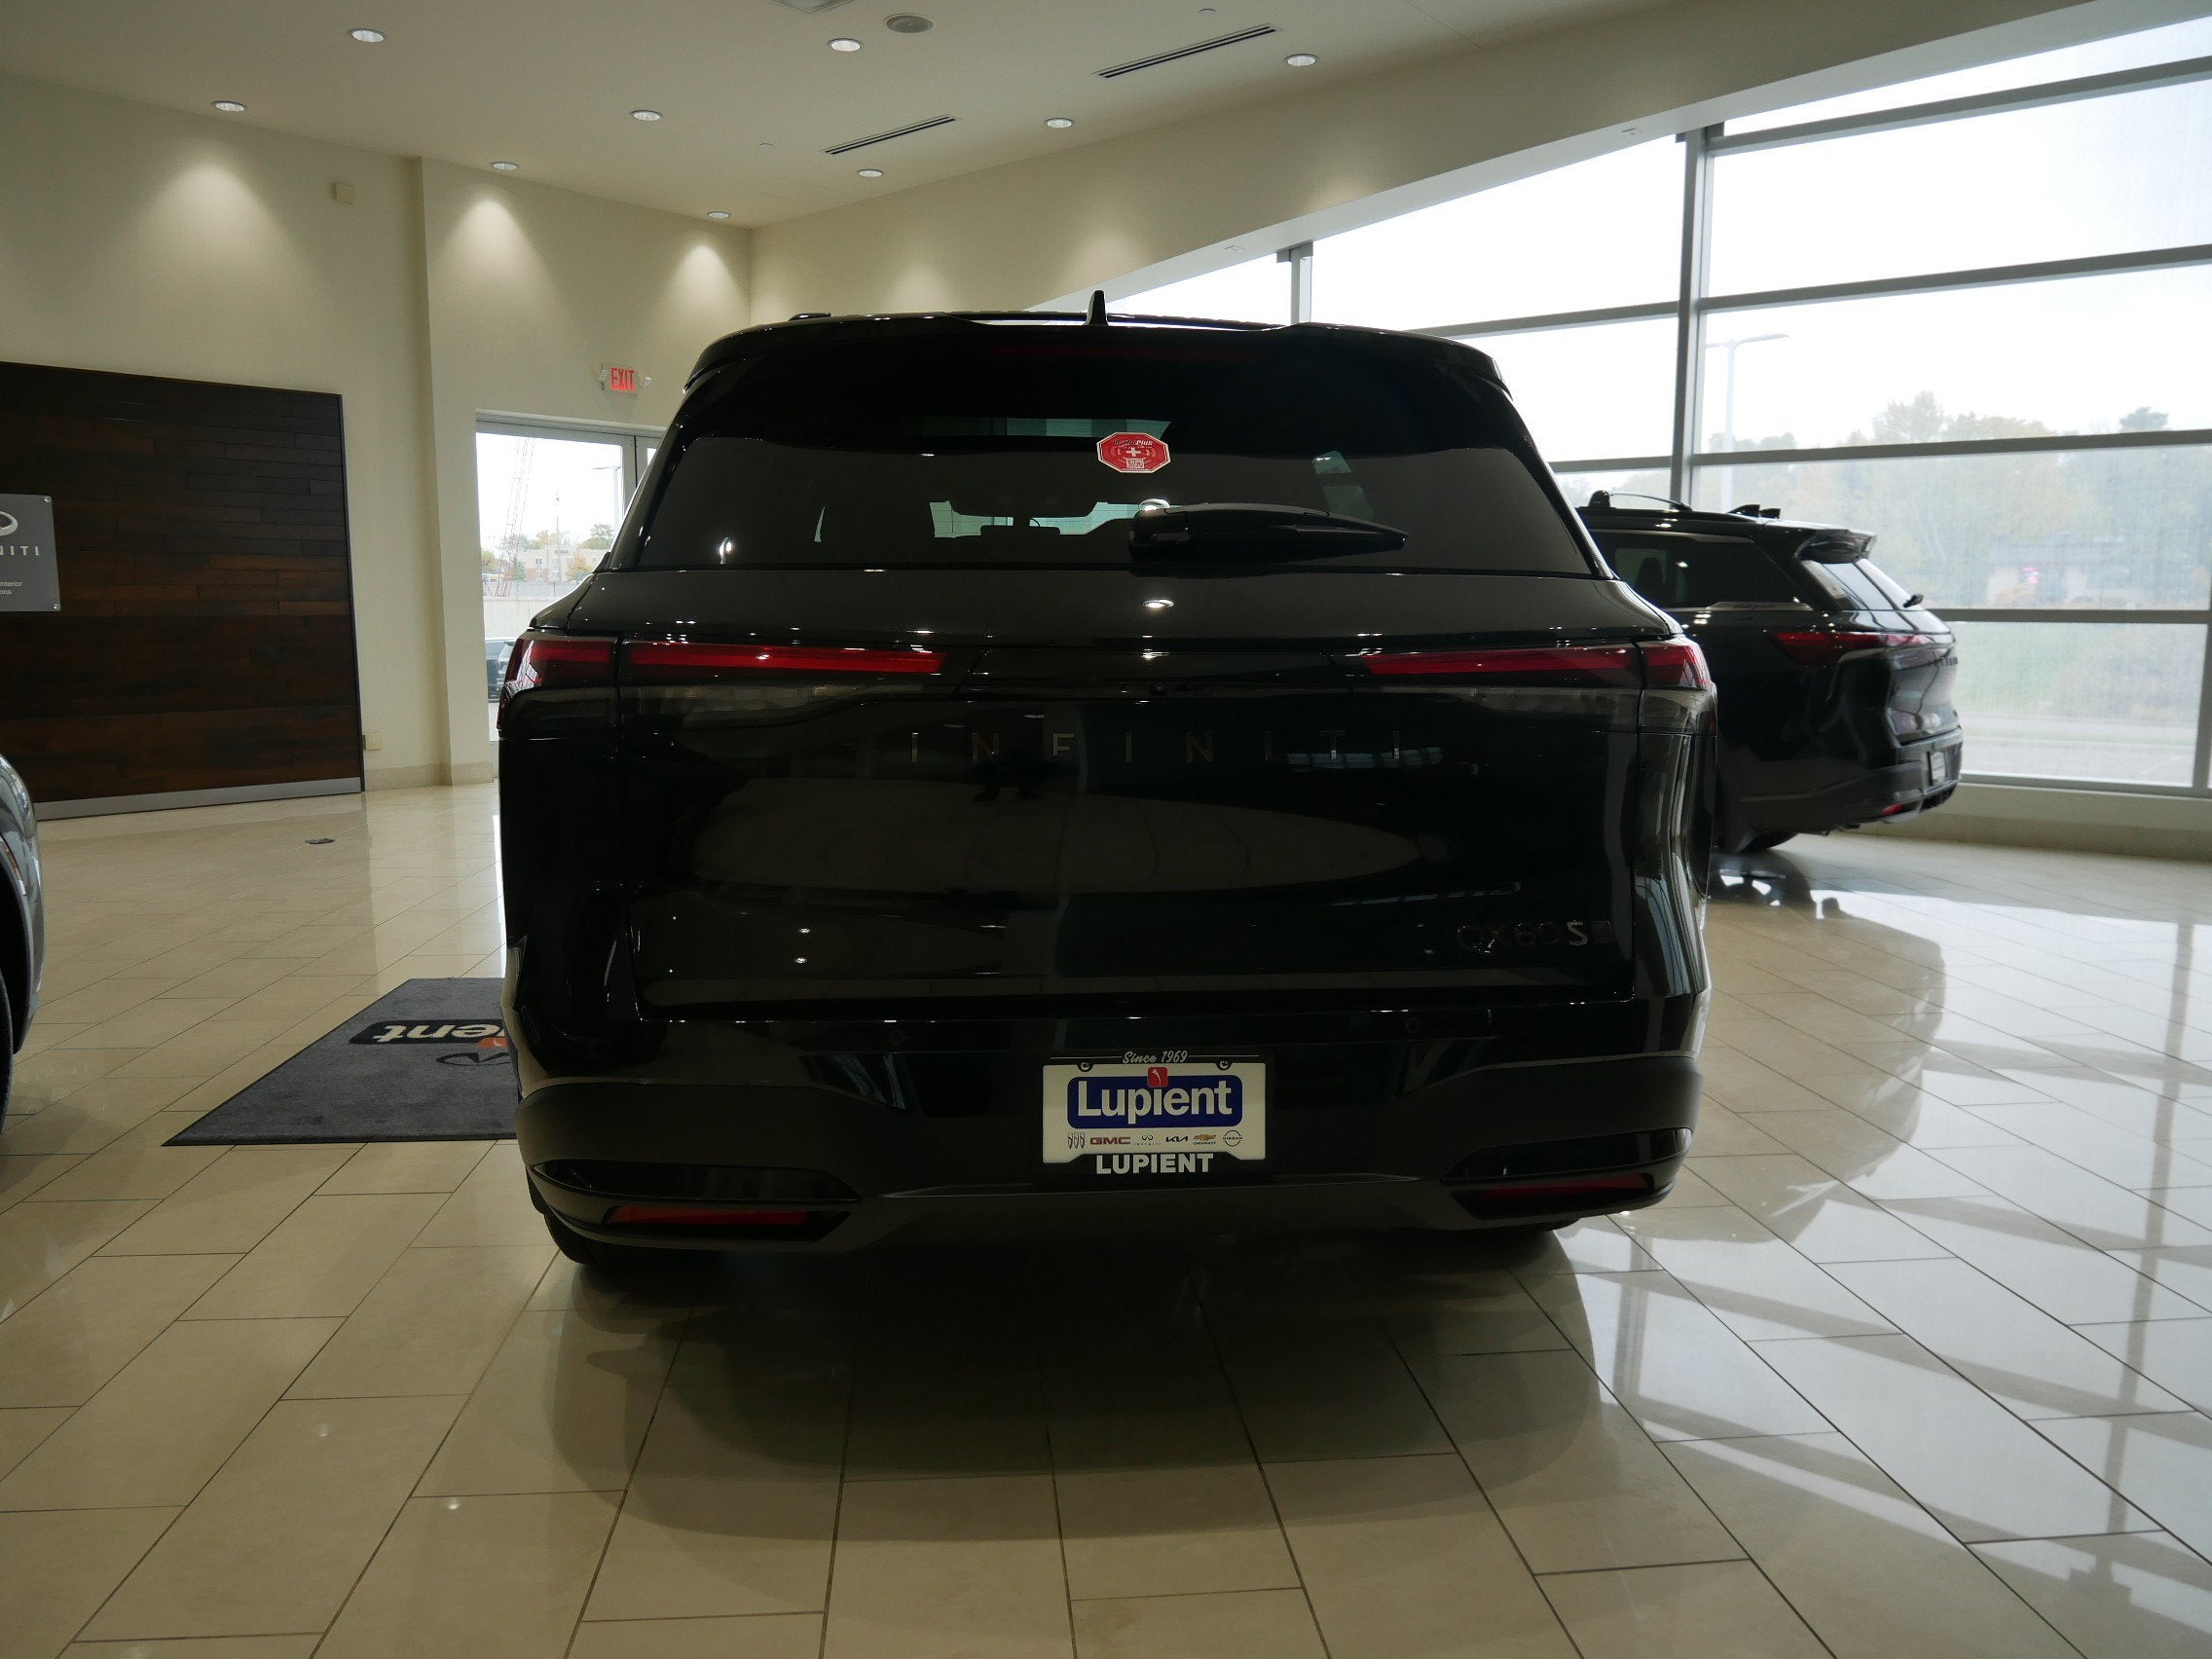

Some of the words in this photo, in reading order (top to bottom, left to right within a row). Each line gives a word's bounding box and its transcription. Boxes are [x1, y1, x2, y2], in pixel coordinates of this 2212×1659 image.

[610, 367, 635, 391] EXIT
[910, 728, 1402, 763] INFINITI
[1122, 1051, 1157, 1064] Since
[1161, 1051, 1189, 1063] 1969
[1078, 1080, 1233, 1124] Lupient
[1089, 1136, 1131, 1146] GMC
[1095, 1153, 1214, 1175] LUPIENT
